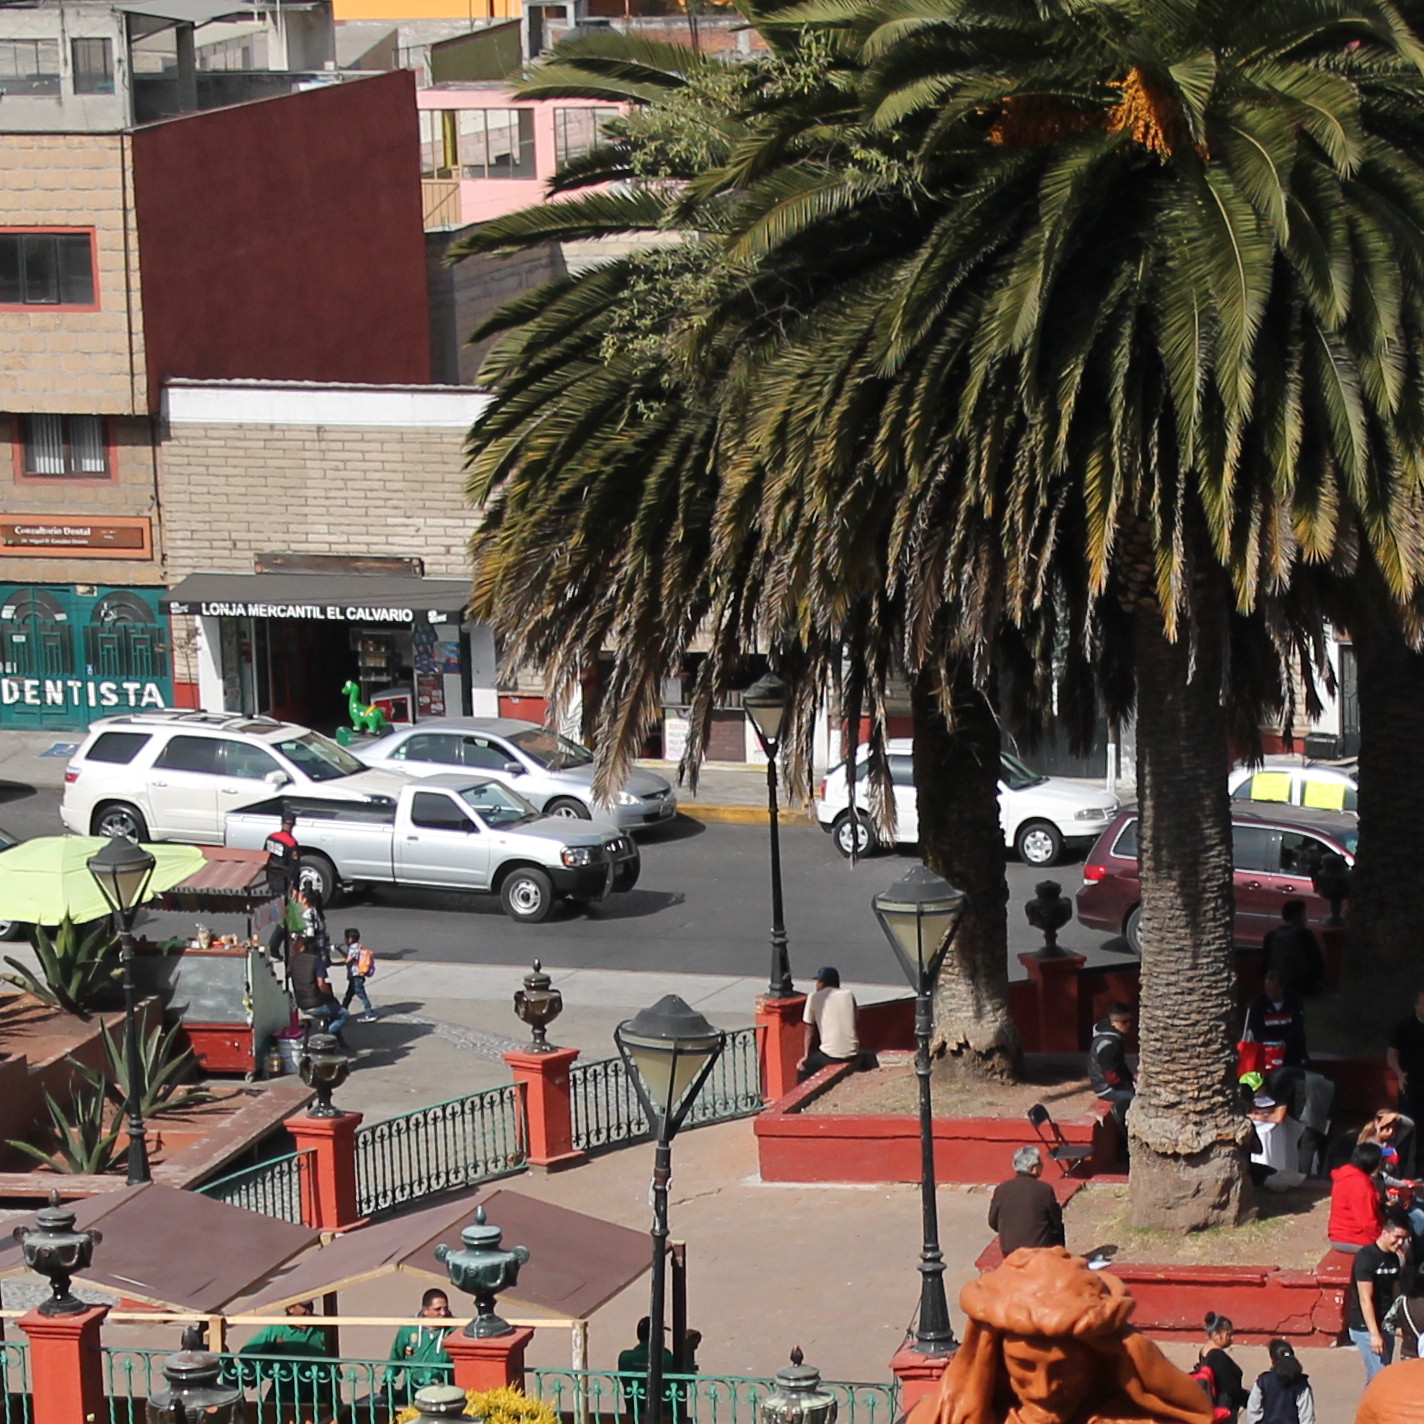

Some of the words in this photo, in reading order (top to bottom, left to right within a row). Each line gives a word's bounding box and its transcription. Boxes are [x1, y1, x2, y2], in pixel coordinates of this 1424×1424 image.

[64, 527, 91, 536] Dental
[201, 602, 247, 616] LONJA
[248, 603, 325, 620] MERCANTIL
[327, 607, 345, 620] EL
[346, 608, 414, 622] CALVARIO
[1, 678, 165, 708] DENTISTA
